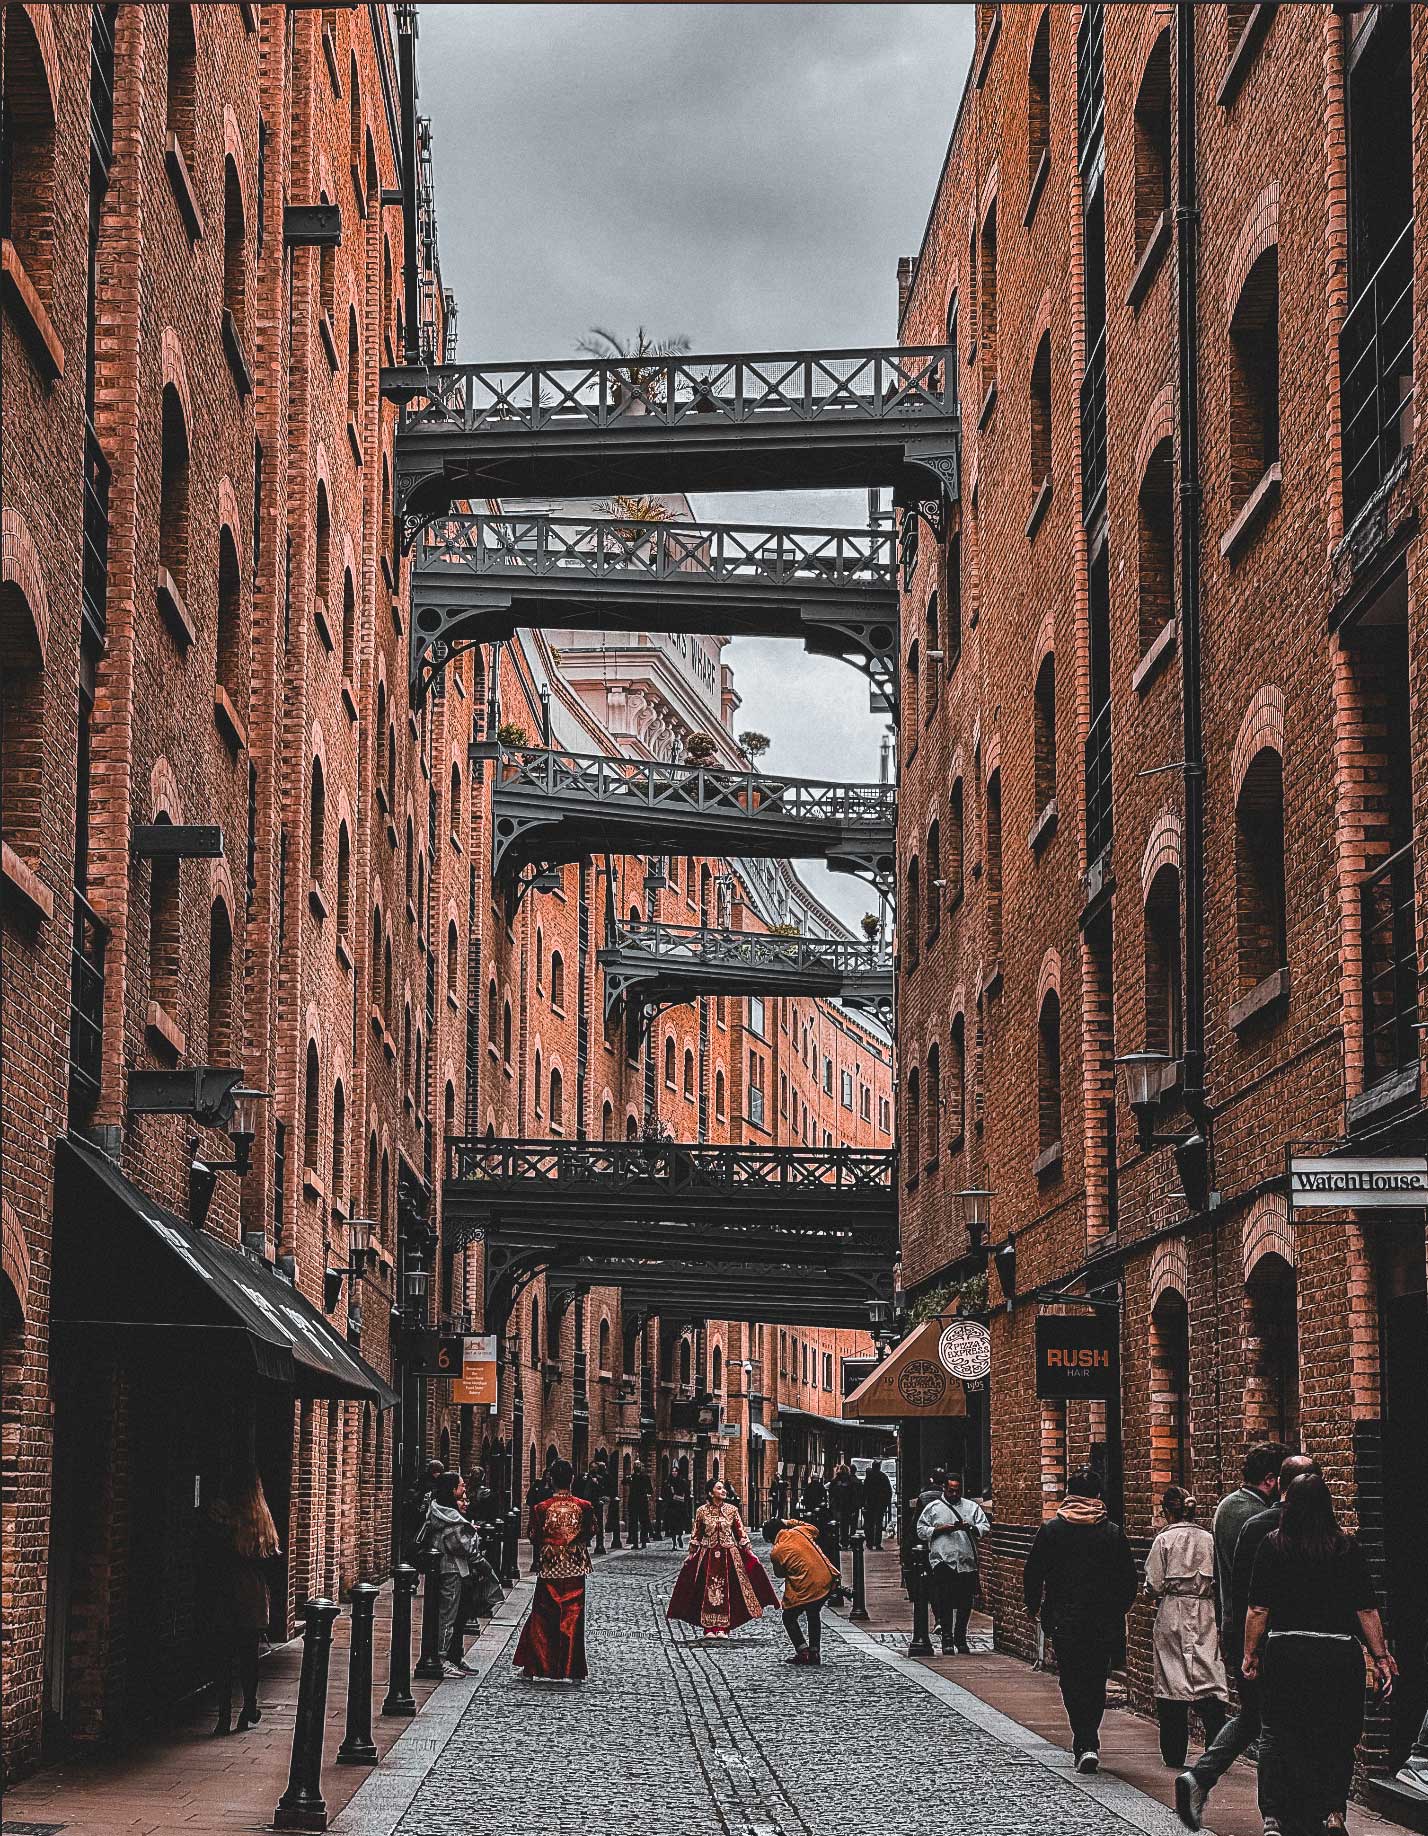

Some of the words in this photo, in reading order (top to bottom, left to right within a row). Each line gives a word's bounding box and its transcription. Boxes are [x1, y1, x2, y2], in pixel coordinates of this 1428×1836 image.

[691, 636, 716, 695] WHARF
[1296, 1173, 1425, 1191] WatchHouse.
[953, 1340, 980, 1351] PIZZA
[438, 1347, 450, 1369] 6
[947, 1346, 990, 1359] EXPRESS
[1047, 1349, 1109, 1367] RUSH
[910, 1375, 934, 1383] PIZZA
[1067, 1369, 1090, 1377] HAIR
[884, 1376, 894, 1385] 19
[966, 1379, 984, 1390] 1965
